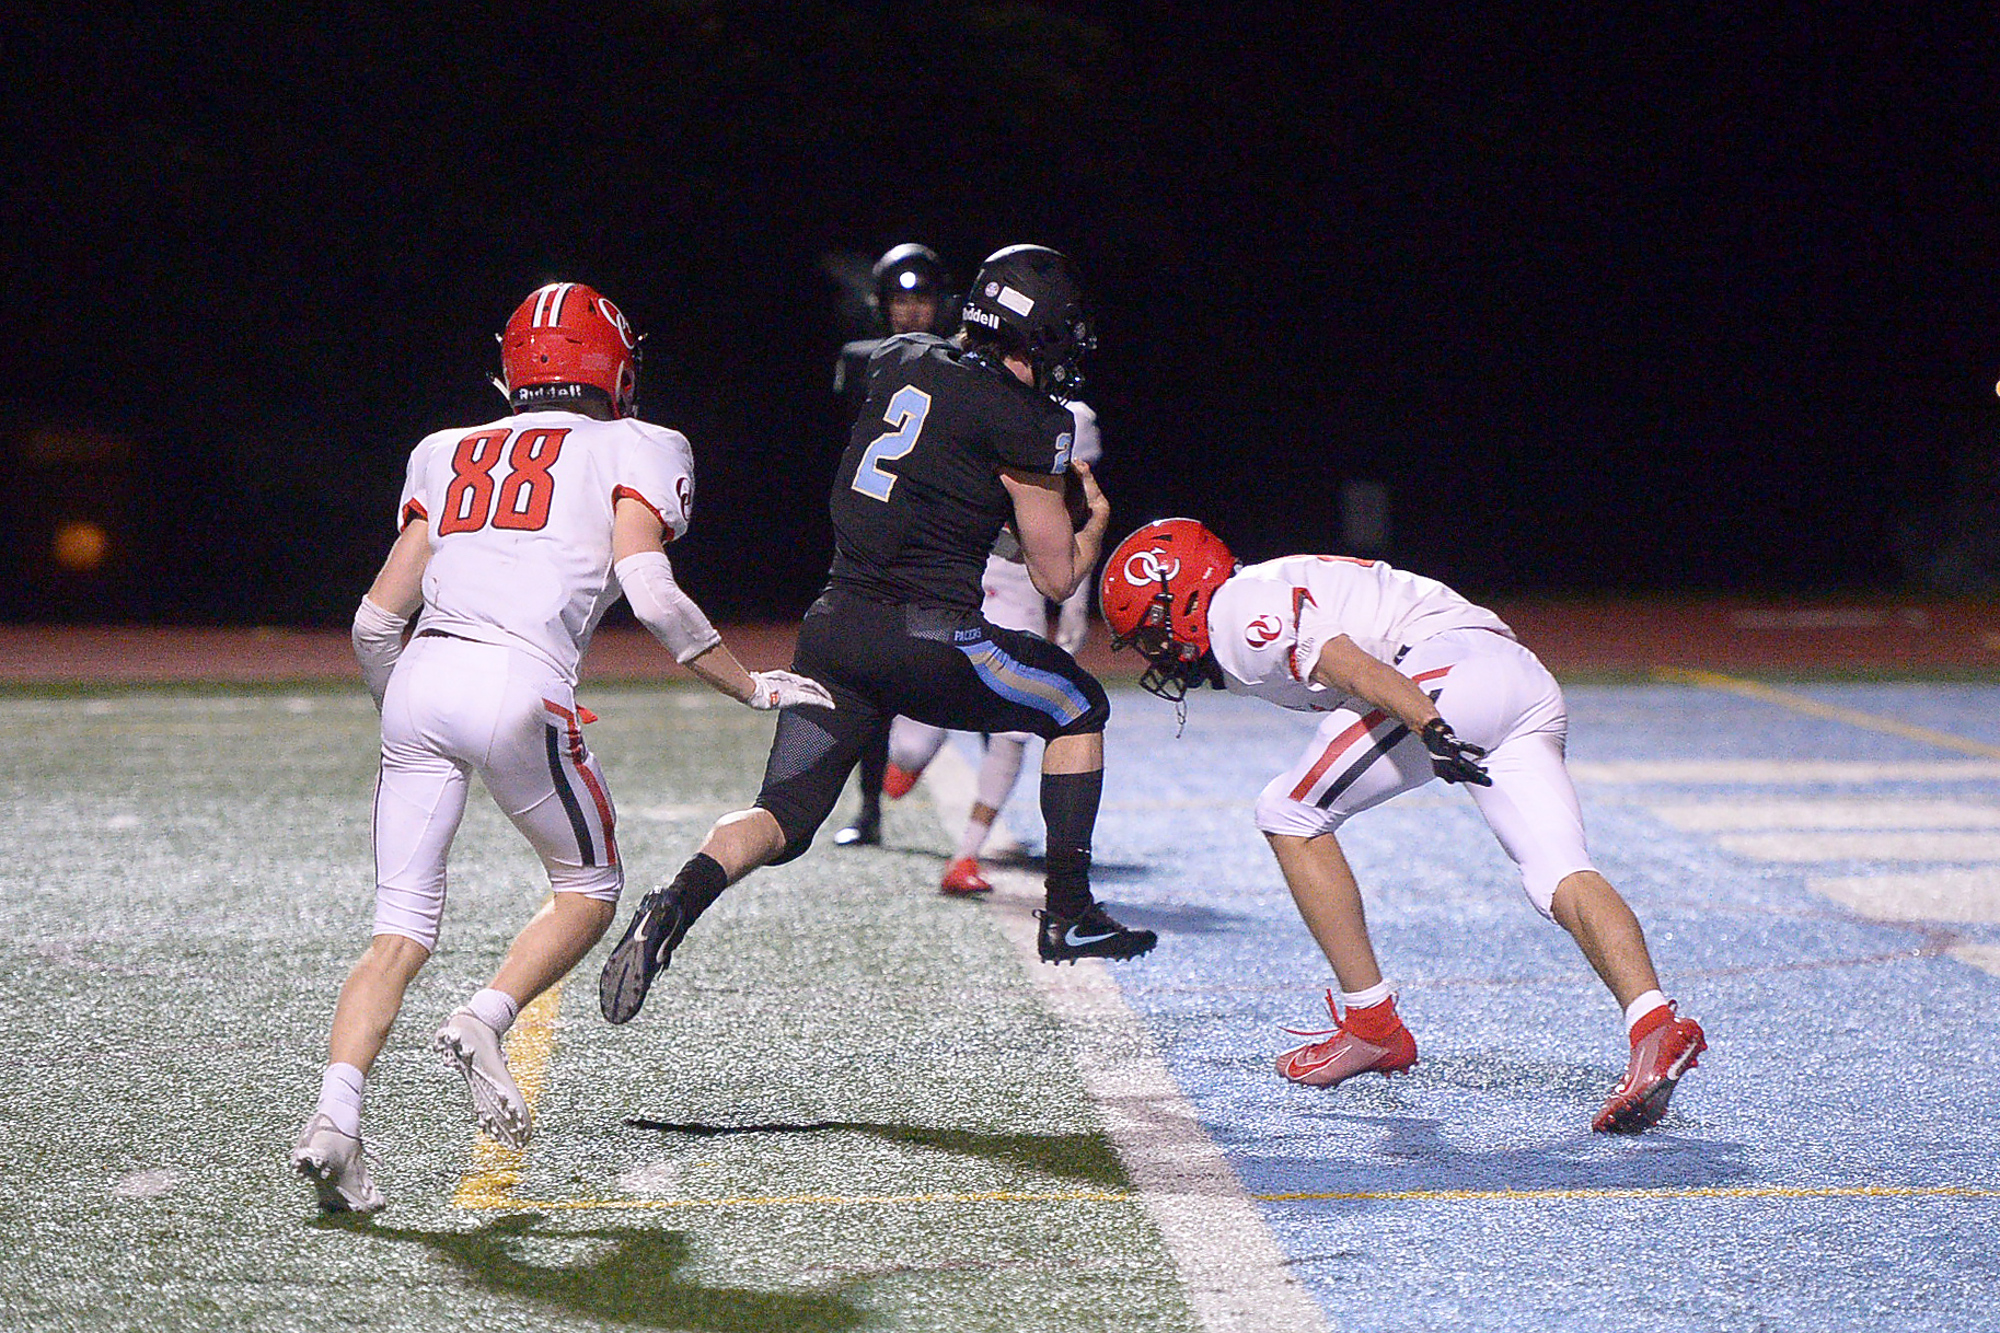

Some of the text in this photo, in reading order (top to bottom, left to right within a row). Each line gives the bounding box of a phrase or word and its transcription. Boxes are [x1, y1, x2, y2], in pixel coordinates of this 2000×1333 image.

[438, 428, 572, 537] 88
[851, 384, 932, 502] 2
[1051, 432, 1072, 474] 2
